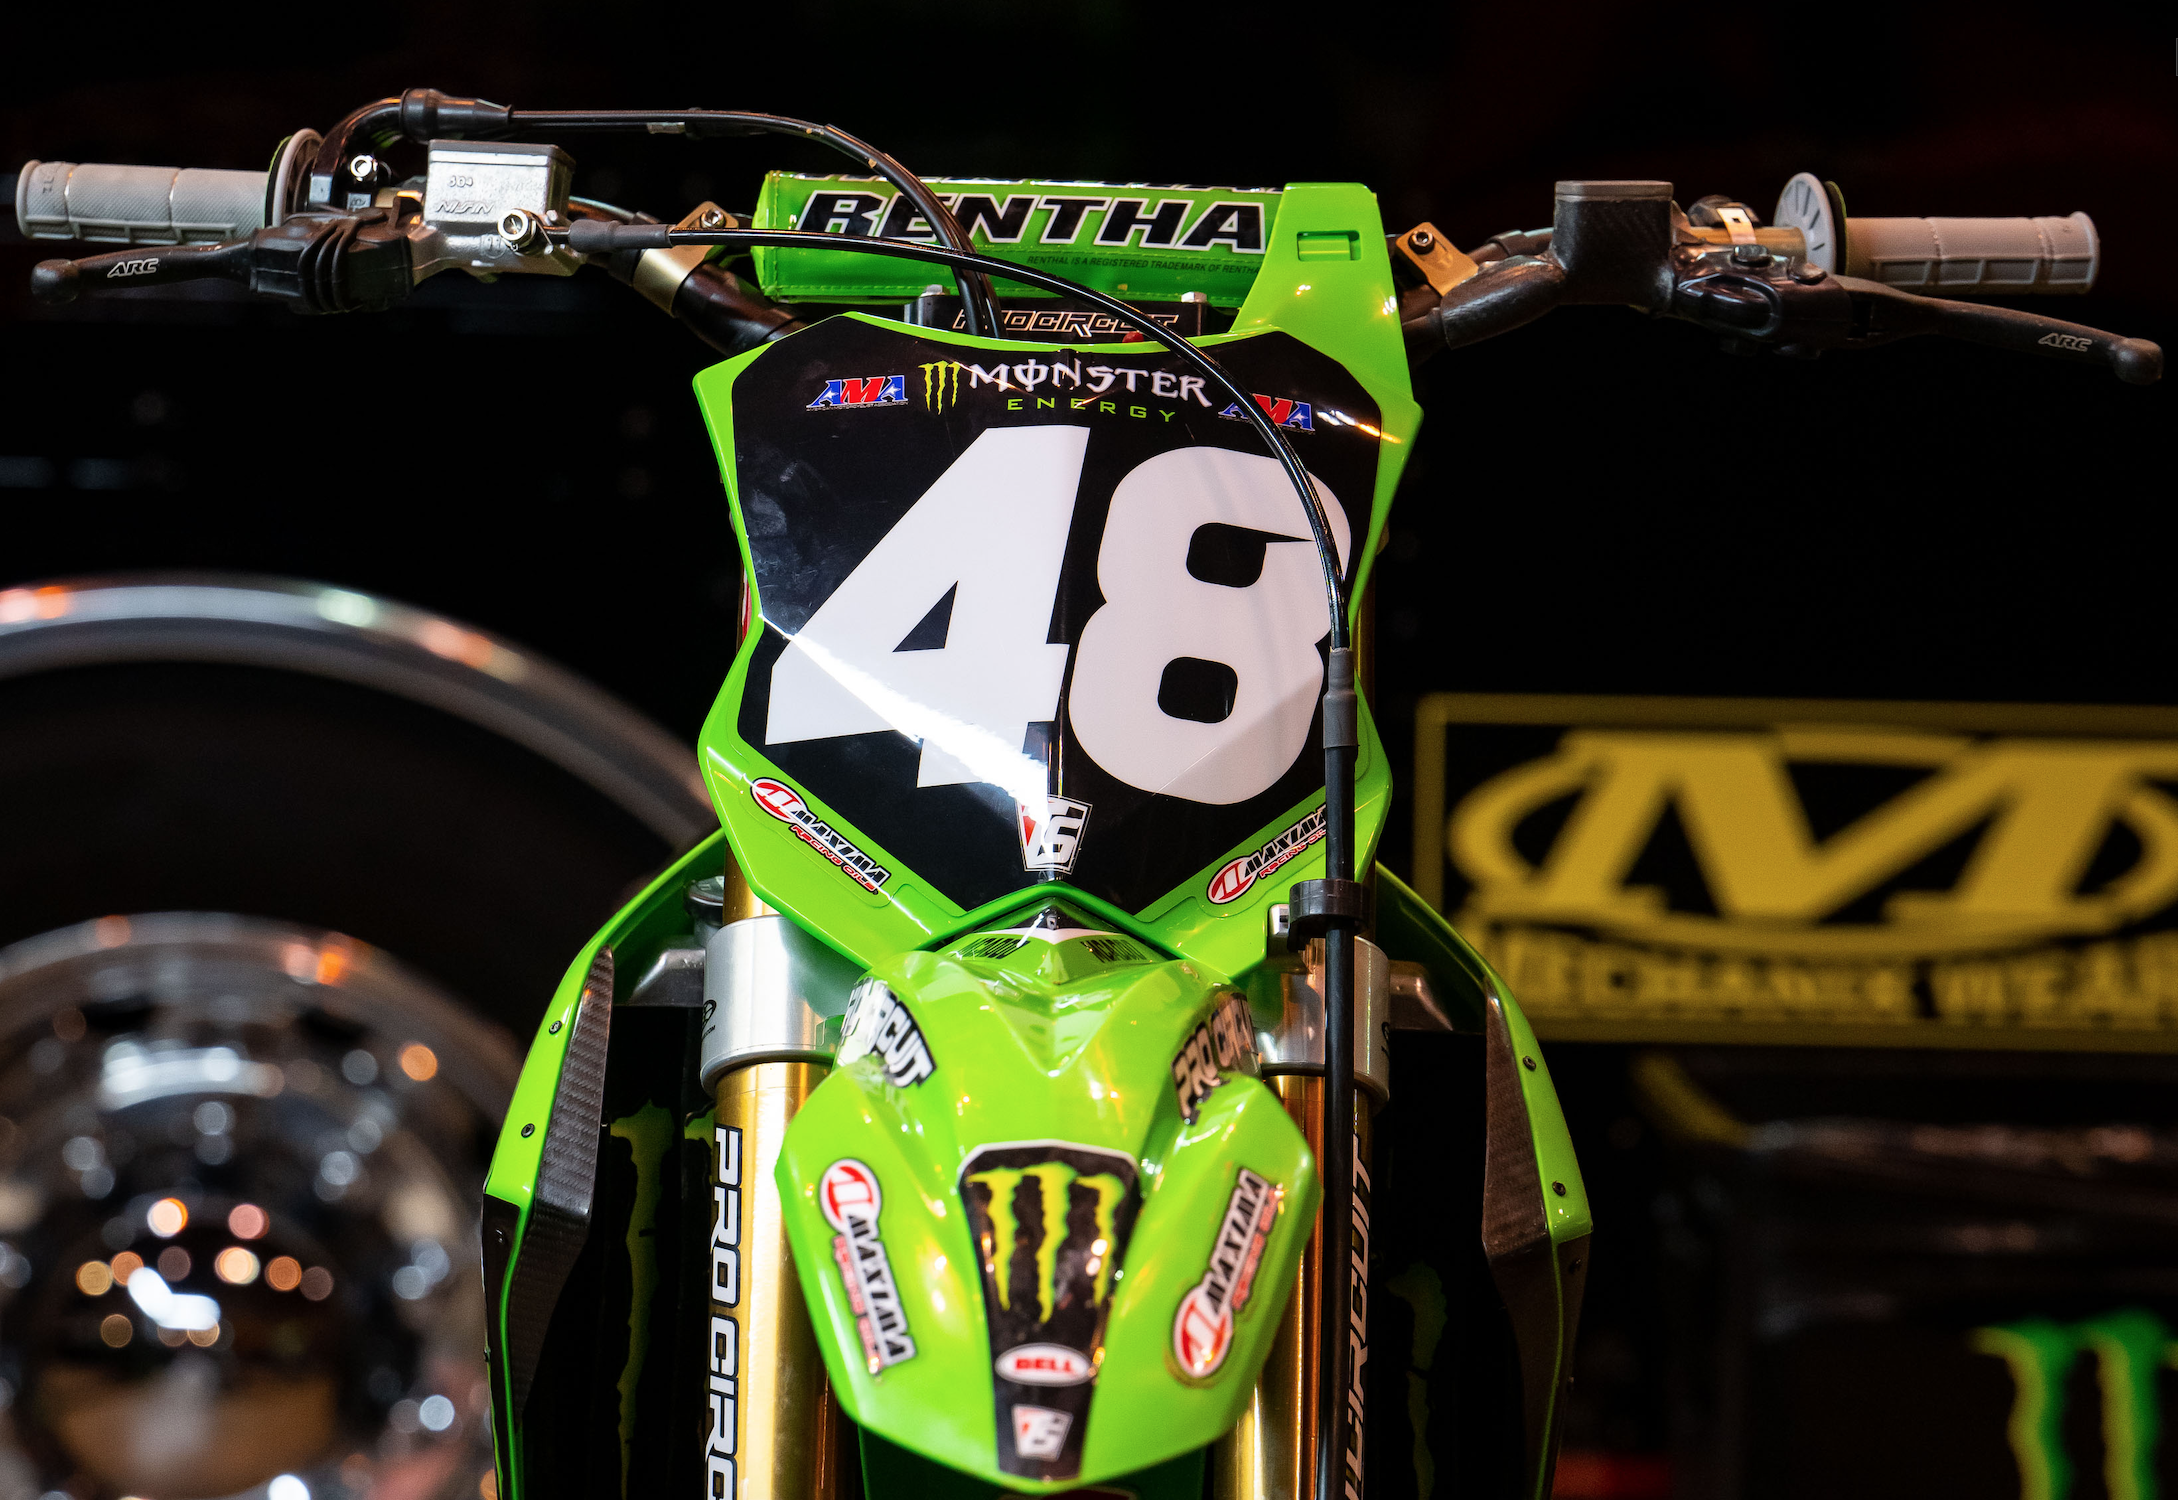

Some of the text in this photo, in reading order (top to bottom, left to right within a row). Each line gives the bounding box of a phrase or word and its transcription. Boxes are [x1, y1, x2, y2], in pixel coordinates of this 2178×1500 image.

[106, 257, 159, 278] ARC
[1026, 255, 1069, 265] RENTHAL
[1070, 257, 1081, 265] IS
[1089, 257, 1149, 268] REGISTERED
[1150, 260, 1206, 271] TRADEMARK
[1207, 263, 1222, 272] OF
[2037, 332, 2093, 352] ARC
[805, 375, 909, 408] AMA
[1007, 397, 1176, 423] ENERGY
[765, 424, 1351, 805] 48
[789, 808, 892, 888] MAXIMA
[790, 825, 845, 865] RACING
[709, 1126, 742, 1306] PRO
